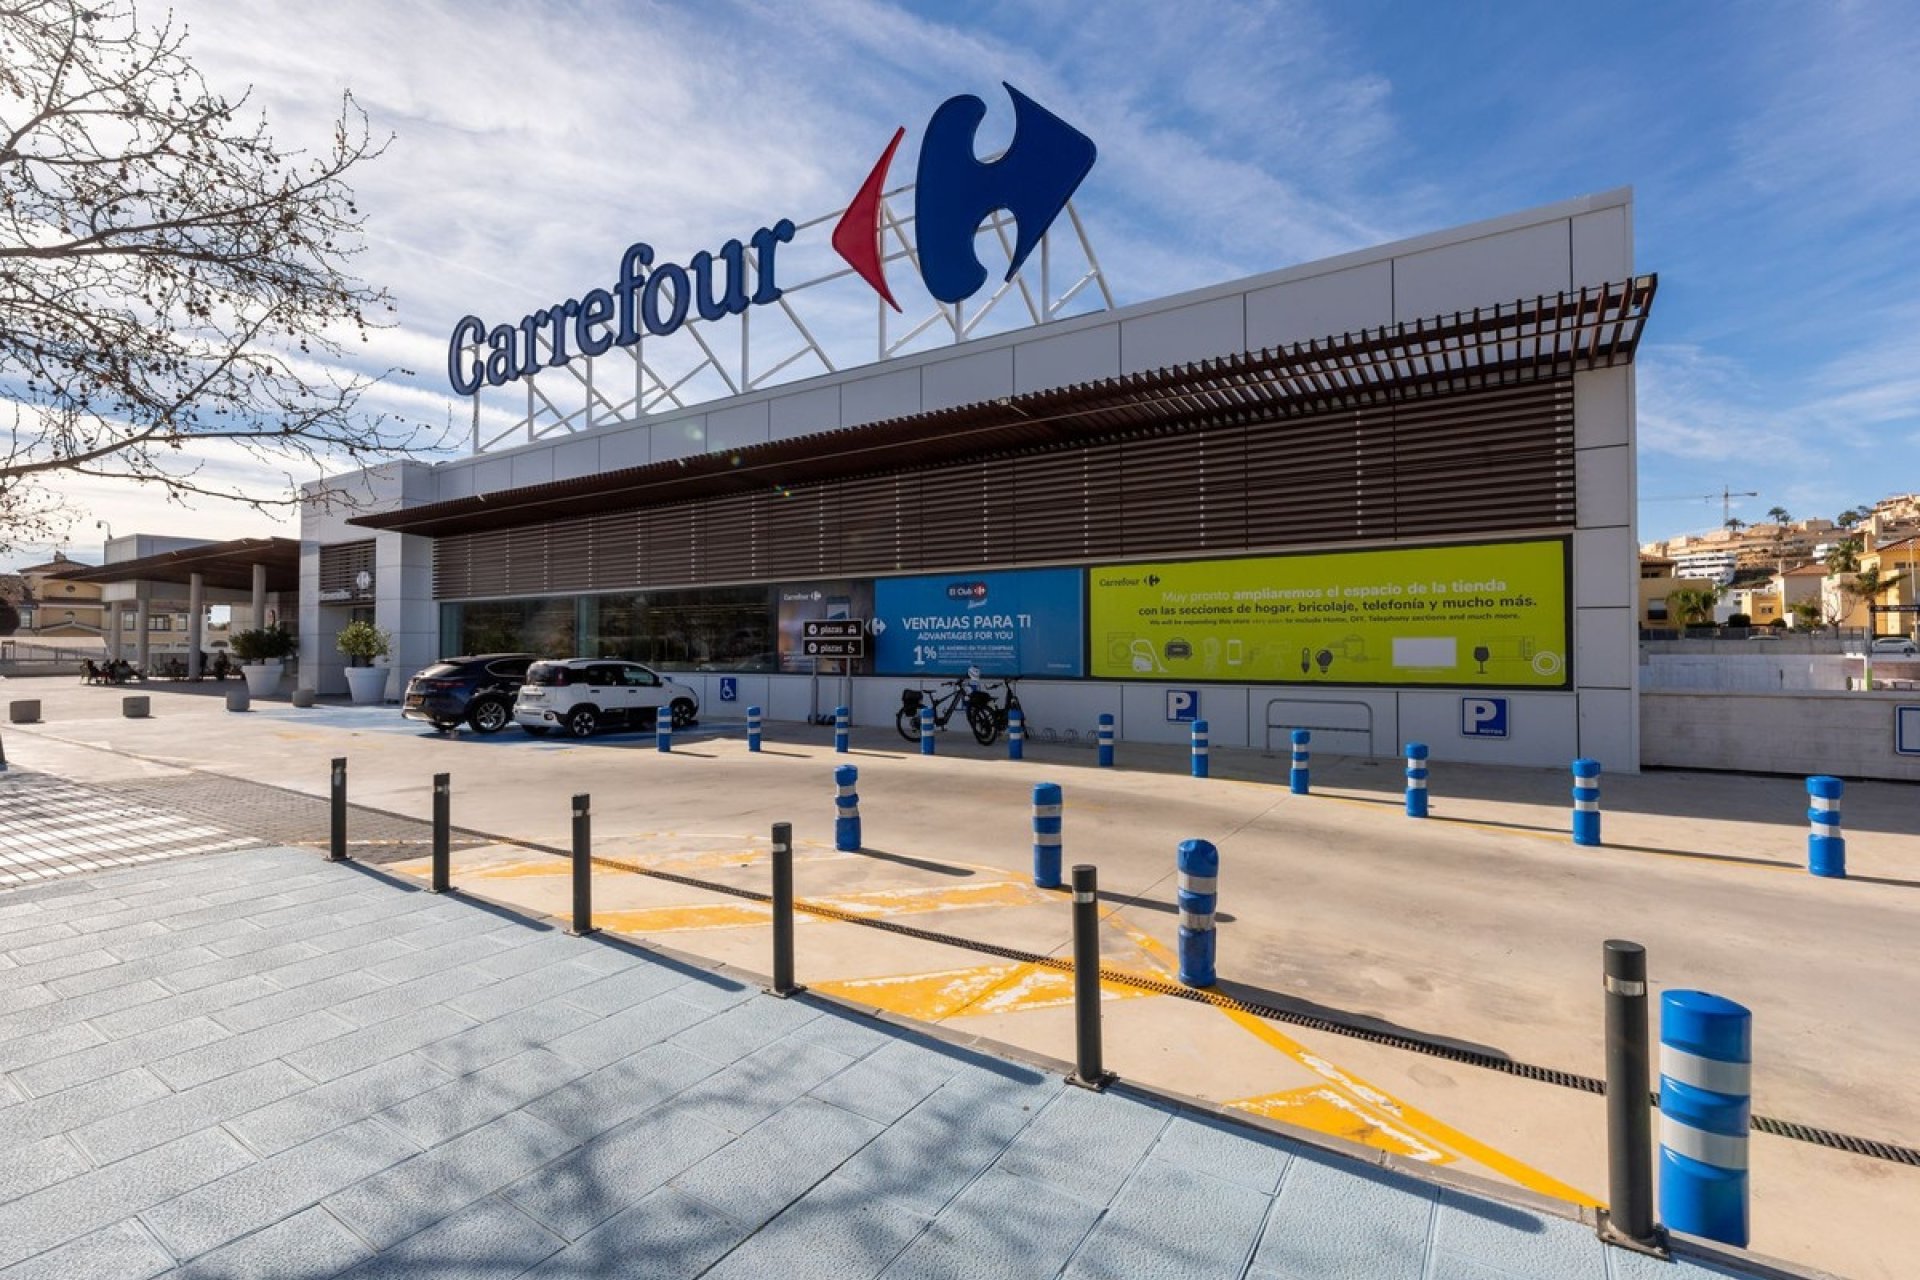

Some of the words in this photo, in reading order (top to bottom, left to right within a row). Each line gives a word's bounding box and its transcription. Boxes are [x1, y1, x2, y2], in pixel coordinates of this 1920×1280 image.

[448, 218, 795, 396] Carrefour
[1099, 577, 1139, 587] Carrefour
[1163, 591, 1187, 602] Muy
[1190, 589, 1229, 601] pronto
[1233, 587, 1321, 602] ampliaremos
[1327, 586, 1339, 596] el
[1344, 583, 1402, 598] espacio
[1407, 583, 1428, 594] de
[1432, 582, 1447, 593] la
[1452, 579, 1507, 592] tienda
[1138, 607, 1158, 616] con
[1160, 605, 1176, 615] las
[1179, 604, 1233, 615] secciones
[1236, 603, 1252, 613] de
[1255, 602, 1295, 614] hogar,
[1298, 600, 1359, 614] bricolaje,
[1362, 598, 1425, 611] telefonía
[1429, 600, 1438, 611] y
[1443, 597, 1495, 608] mucho
[1500, 594, 1537, 607] más.
[902, 615, 970, 630] VENTAJAS
[973, 613, 1013, 629] PARA
[1016, 613, 1031, 628] TI
[918, 631, 973, 641] ADVANTAGES
[974, 631, 992, 640] FOR
[993, 631, 1014, 640] YOU
[913, 645, 937, 665] 1%
[1167, 692, 1192, 719] P
[1463, 700, 1497, 733] P
